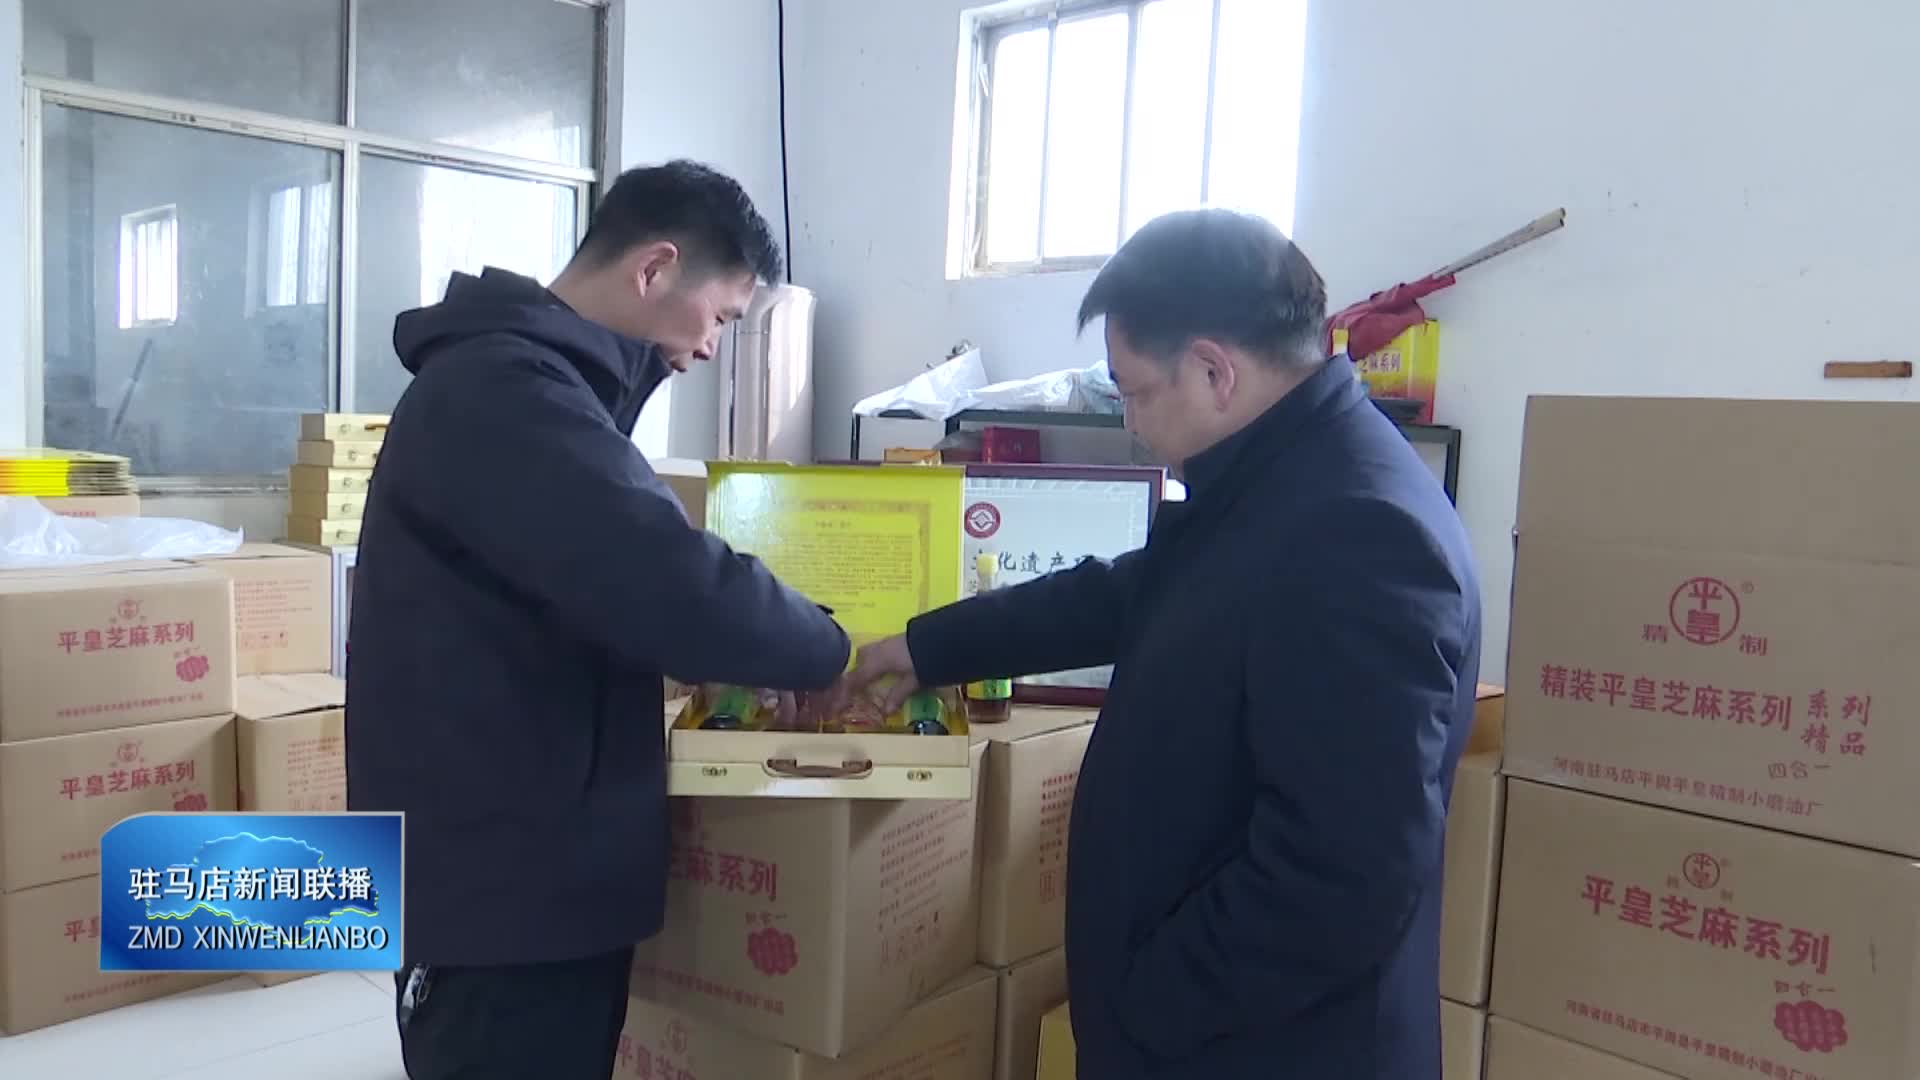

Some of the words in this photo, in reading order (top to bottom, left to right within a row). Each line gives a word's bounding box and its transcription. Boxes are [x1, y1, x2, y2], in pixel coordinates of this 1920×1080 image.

[970, 549, 1092, 574] 化遗产
[57, 620, 194, 654] 平皇芝麻系列
[1541, 665, 1792, 731] 精装平皇芝麻系列
[60, 760, 194, 800] 平皇芝麻系列
[1768, 760, 1831, 780] 四合一
[1580, 874, 1830, 975] 平皇芝麻系列
